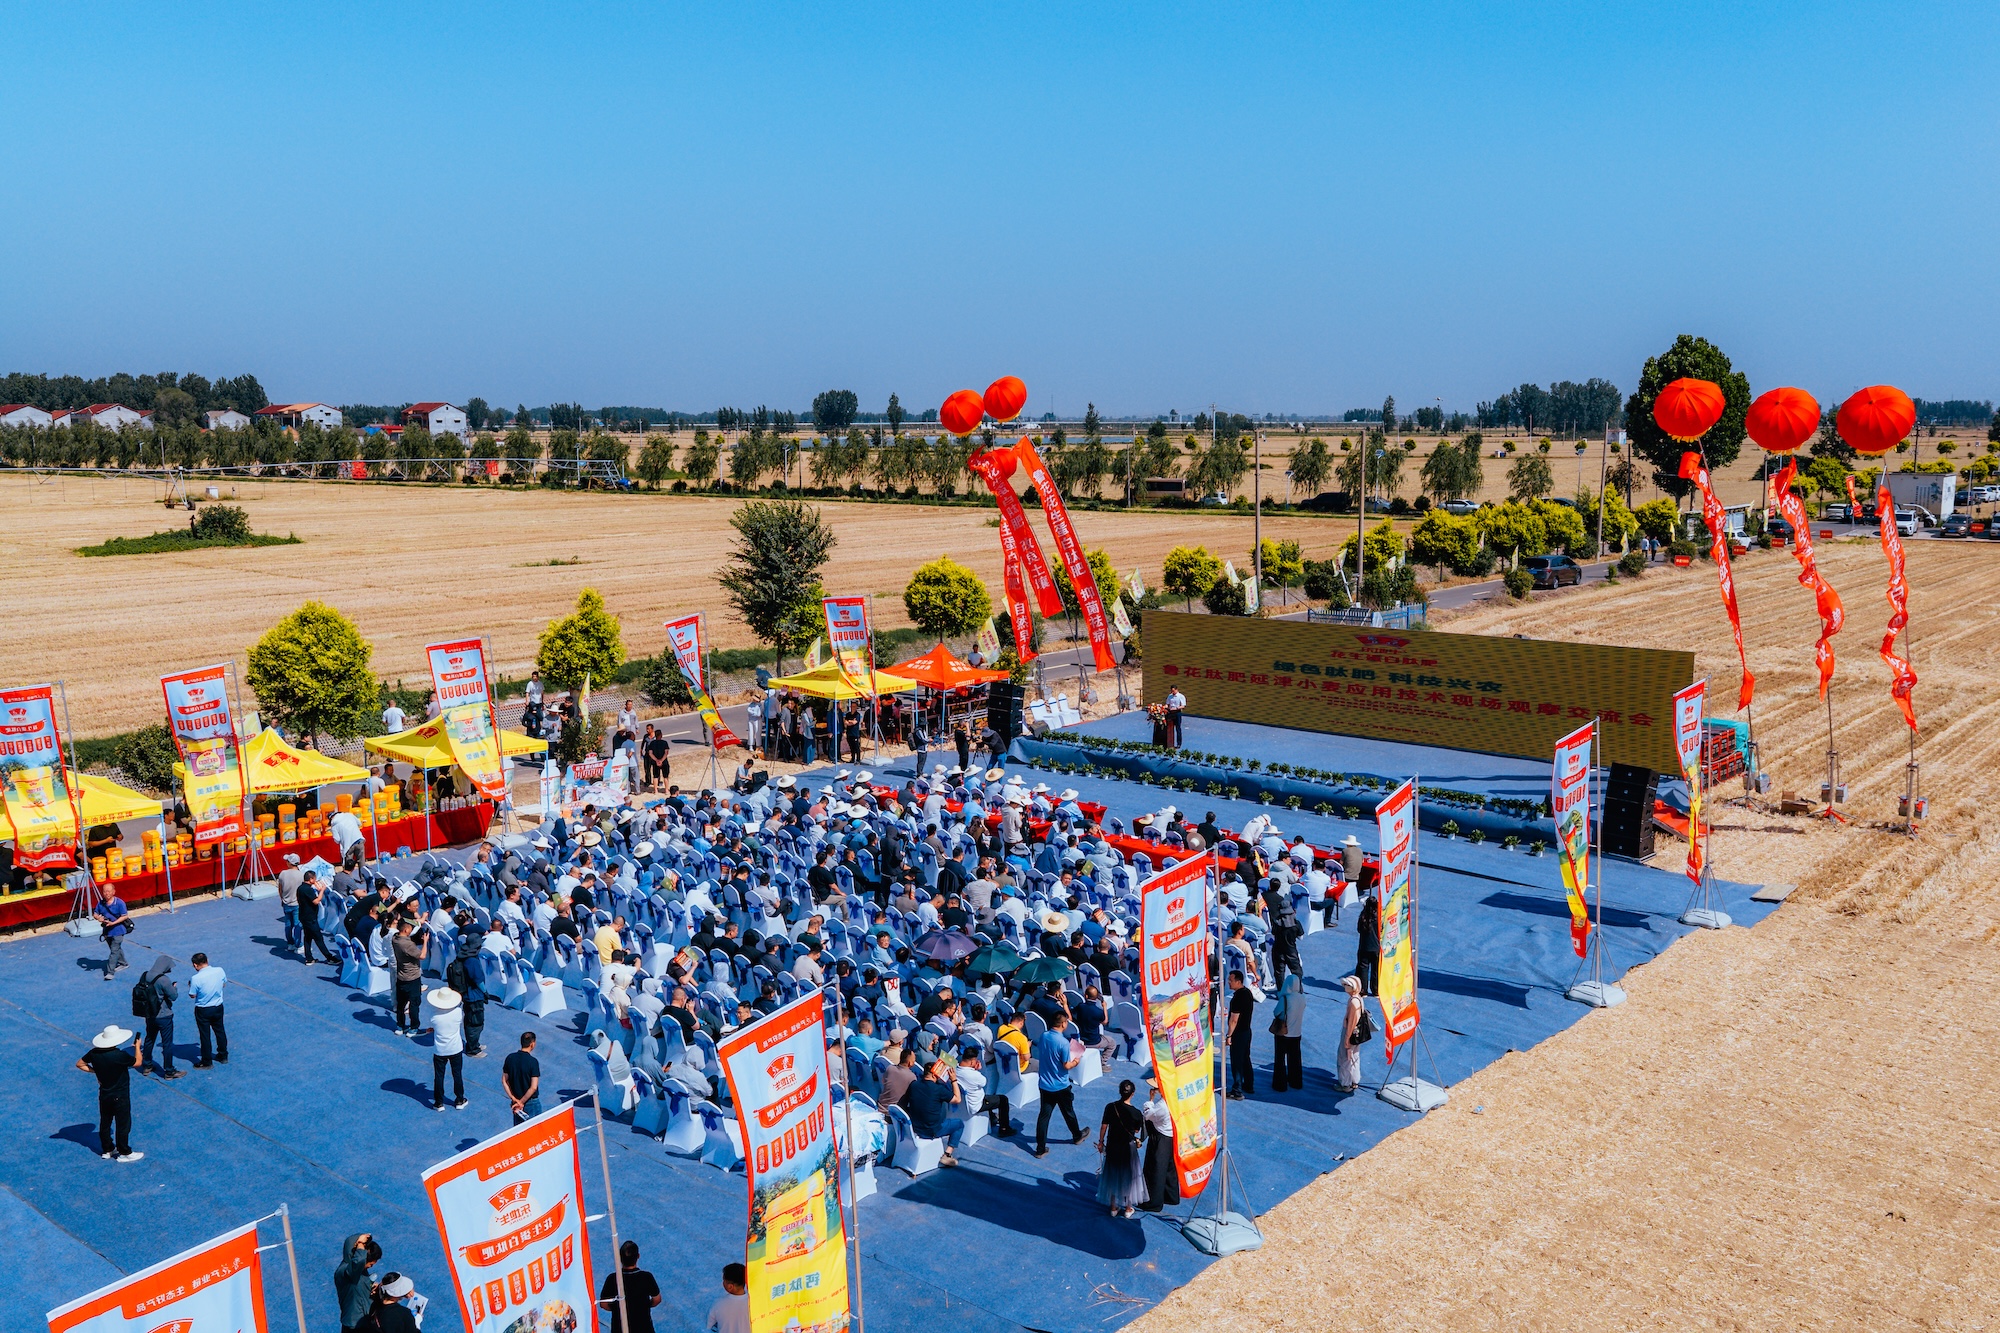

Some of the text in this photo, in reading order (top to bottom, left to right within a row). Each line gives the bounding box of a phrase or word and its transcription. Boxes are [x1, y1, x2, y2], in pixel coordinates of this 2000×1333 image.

[1019, 537, 1050, 590] 改良土壤
[1032, 468, 1106, 643] 鲁花花生蛋白肽肥 抑菌祛病
[1162, 664, 1655, 727] 鲁花肽肥延津小麦应用技术现场观摩交流会
[1273, 660, 1503, 693] 绿色肽肥 科技兴农
